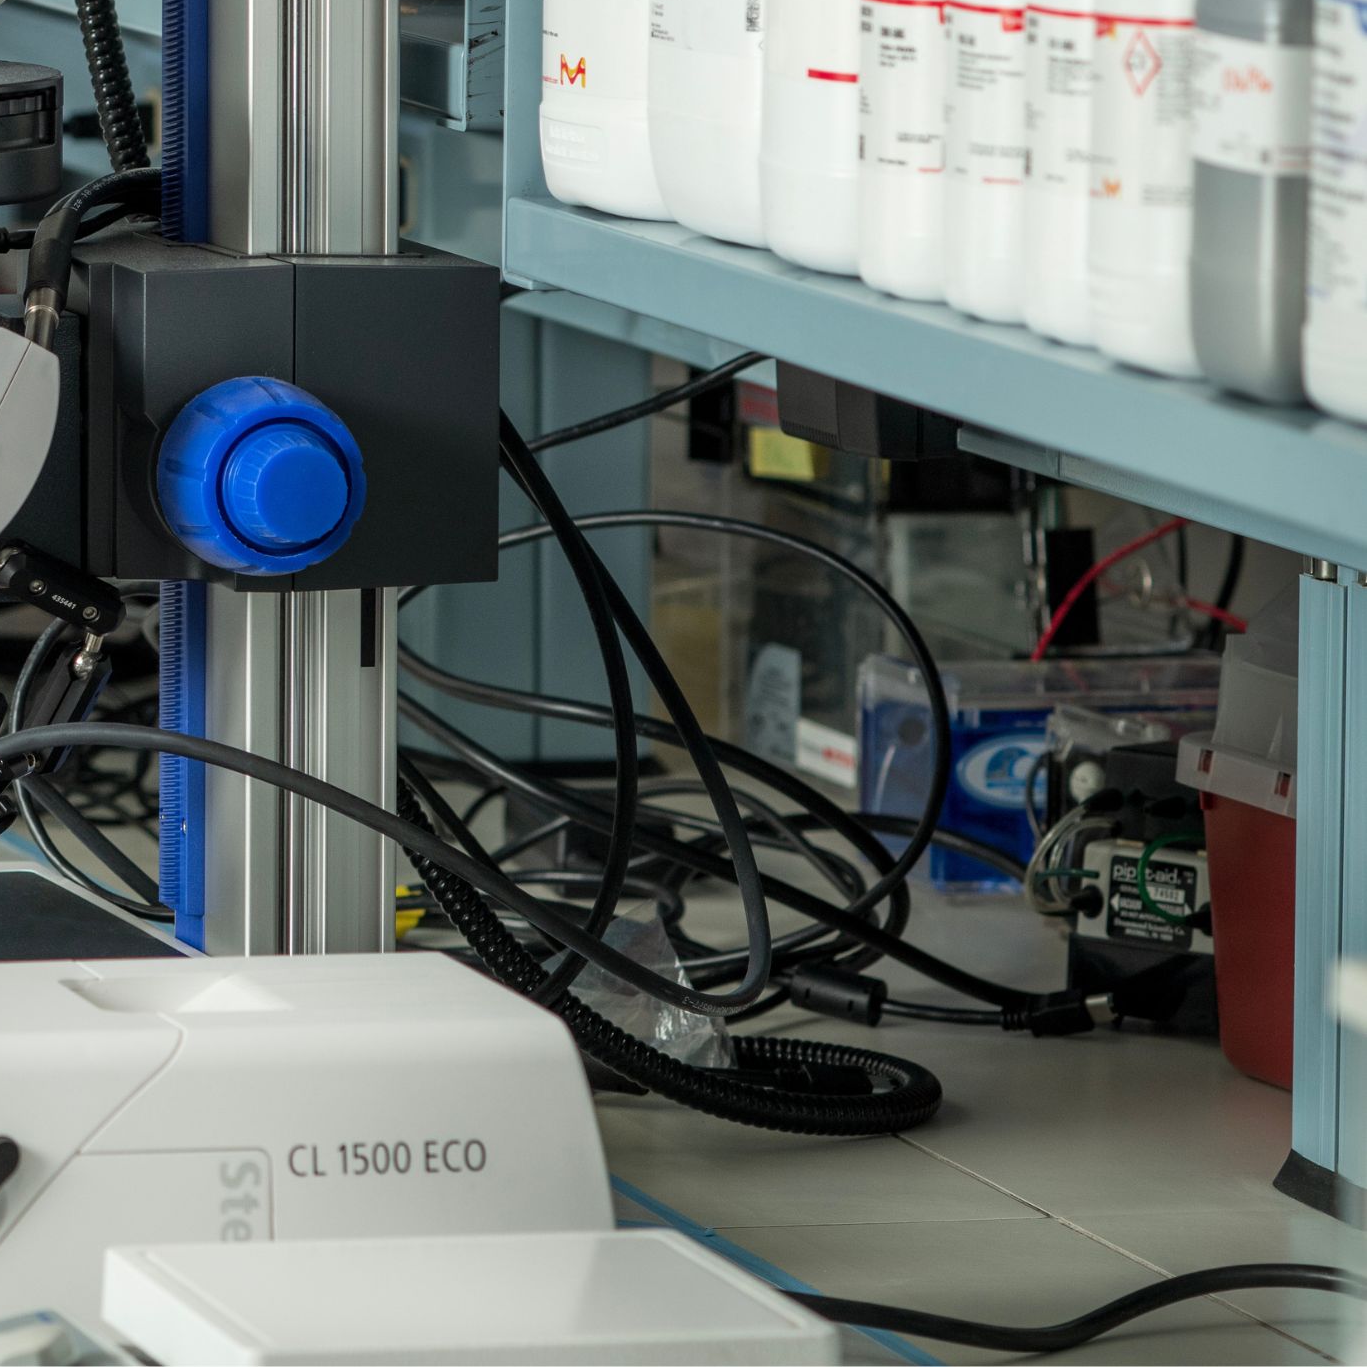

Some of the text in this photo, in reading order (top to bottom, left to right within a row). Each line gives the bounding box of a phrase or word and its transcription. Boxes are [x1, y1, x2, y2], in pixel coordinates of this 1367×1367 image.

[288, 1138, 488, 1177] CL 1500 ECO
[219, 1161, 263, 1243] Ste
